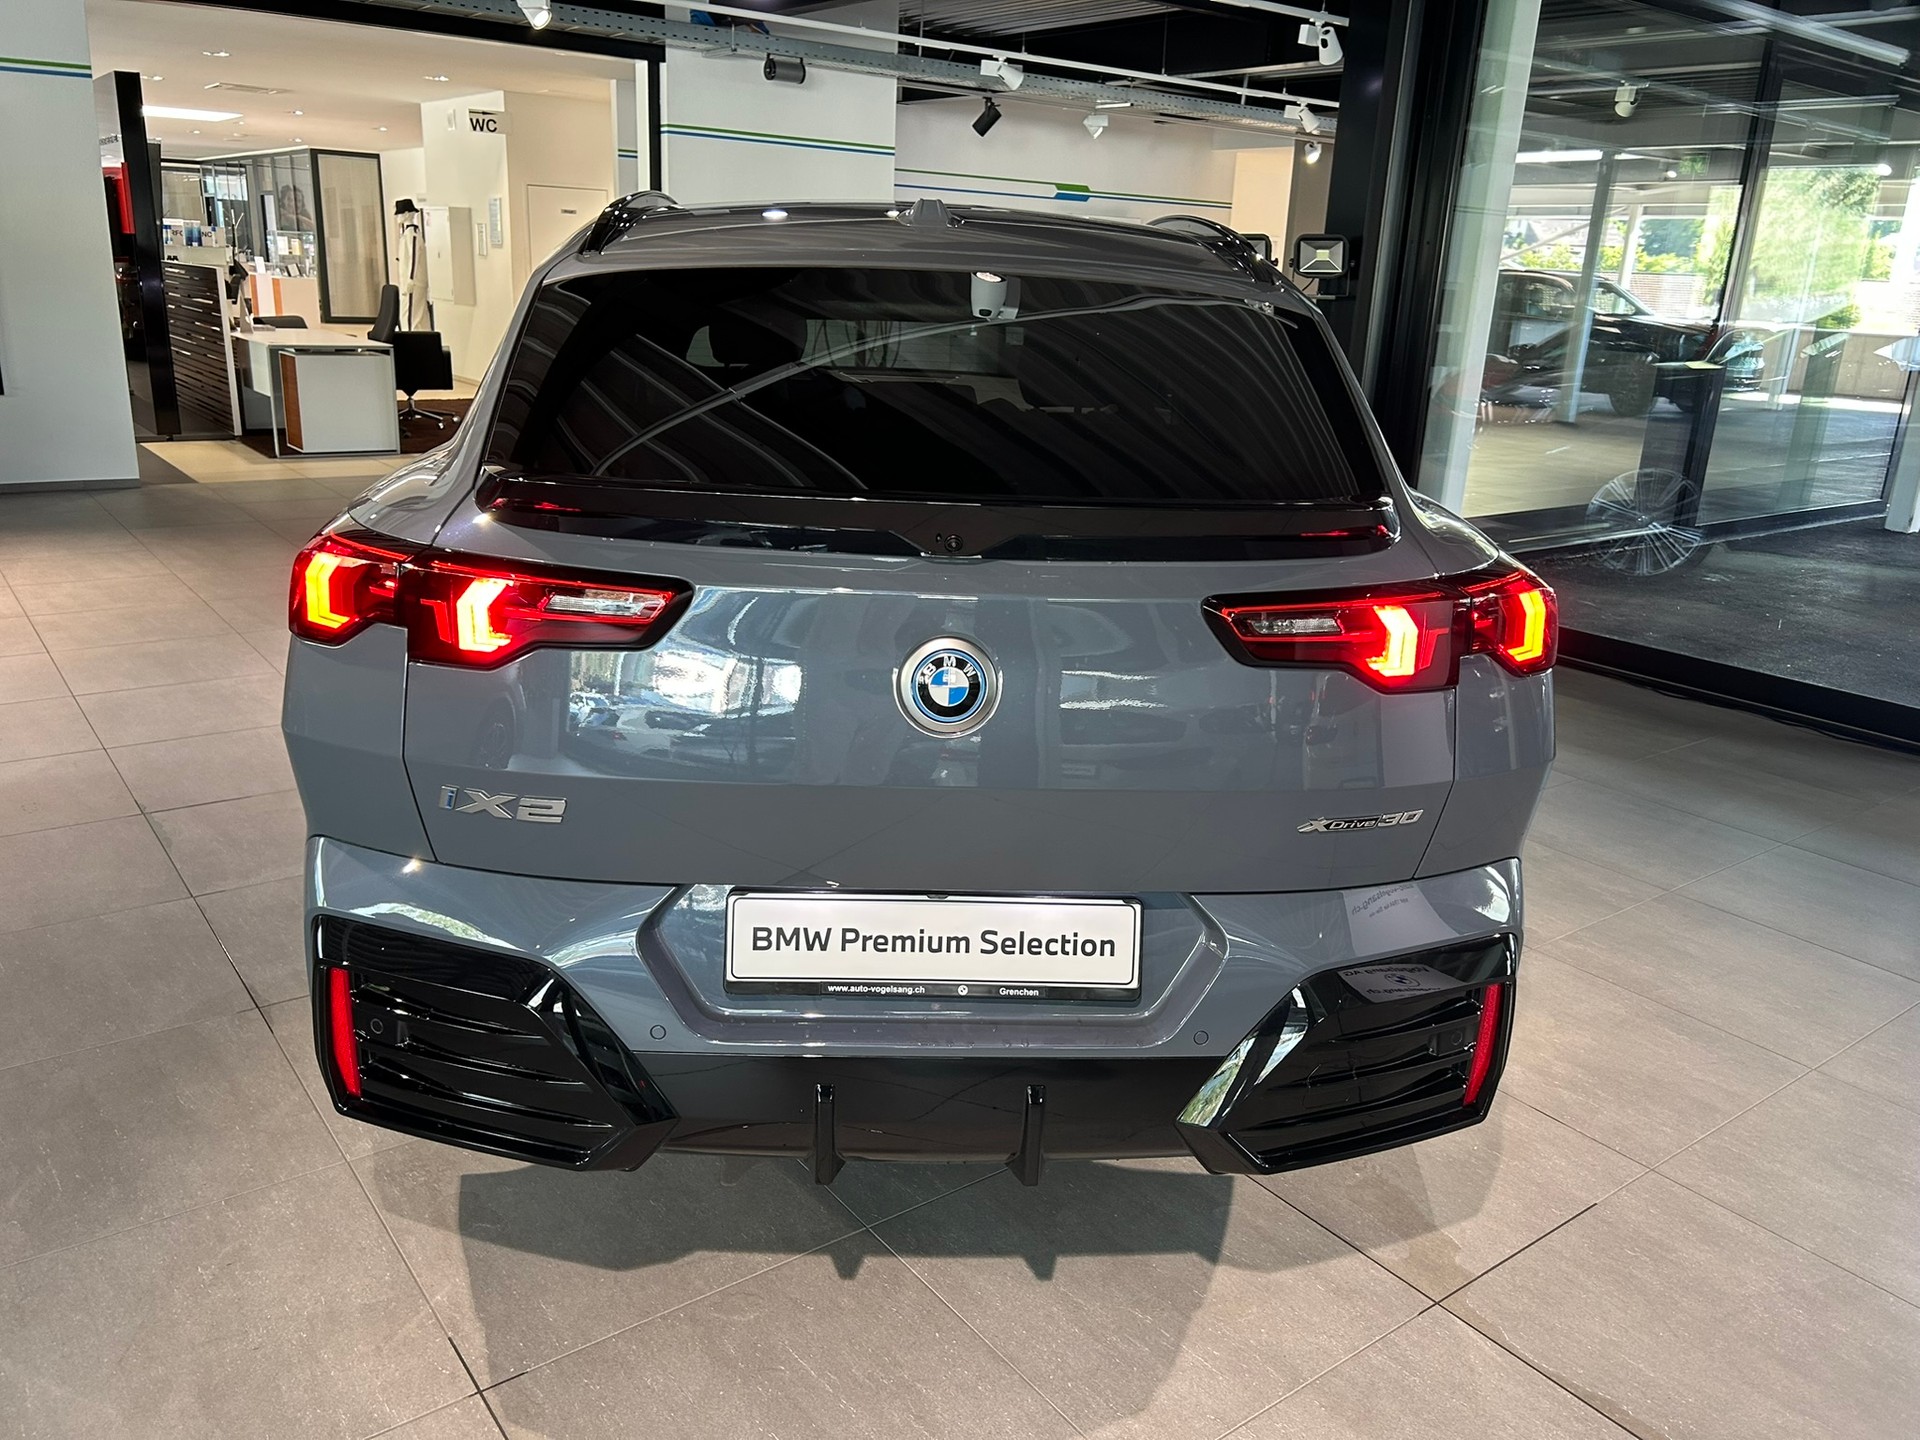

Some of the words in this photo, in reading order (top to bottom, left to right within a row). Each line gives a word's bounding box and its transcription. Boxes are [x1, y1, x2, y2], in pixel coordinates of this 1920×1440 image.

[469, 117, 498, 133] WC
[922, 655, 977, 678] BMW
[438, 784, 567, 823] iX2
[752, 926, 832, 951] BMW
[841, 927, 970, 954] Premium
[980, 929, 1116, 957] Selection
[826, 984, 926, 995] www.auto-vogelsang.ch
[998, 986, 1040, 997] Grenchen
